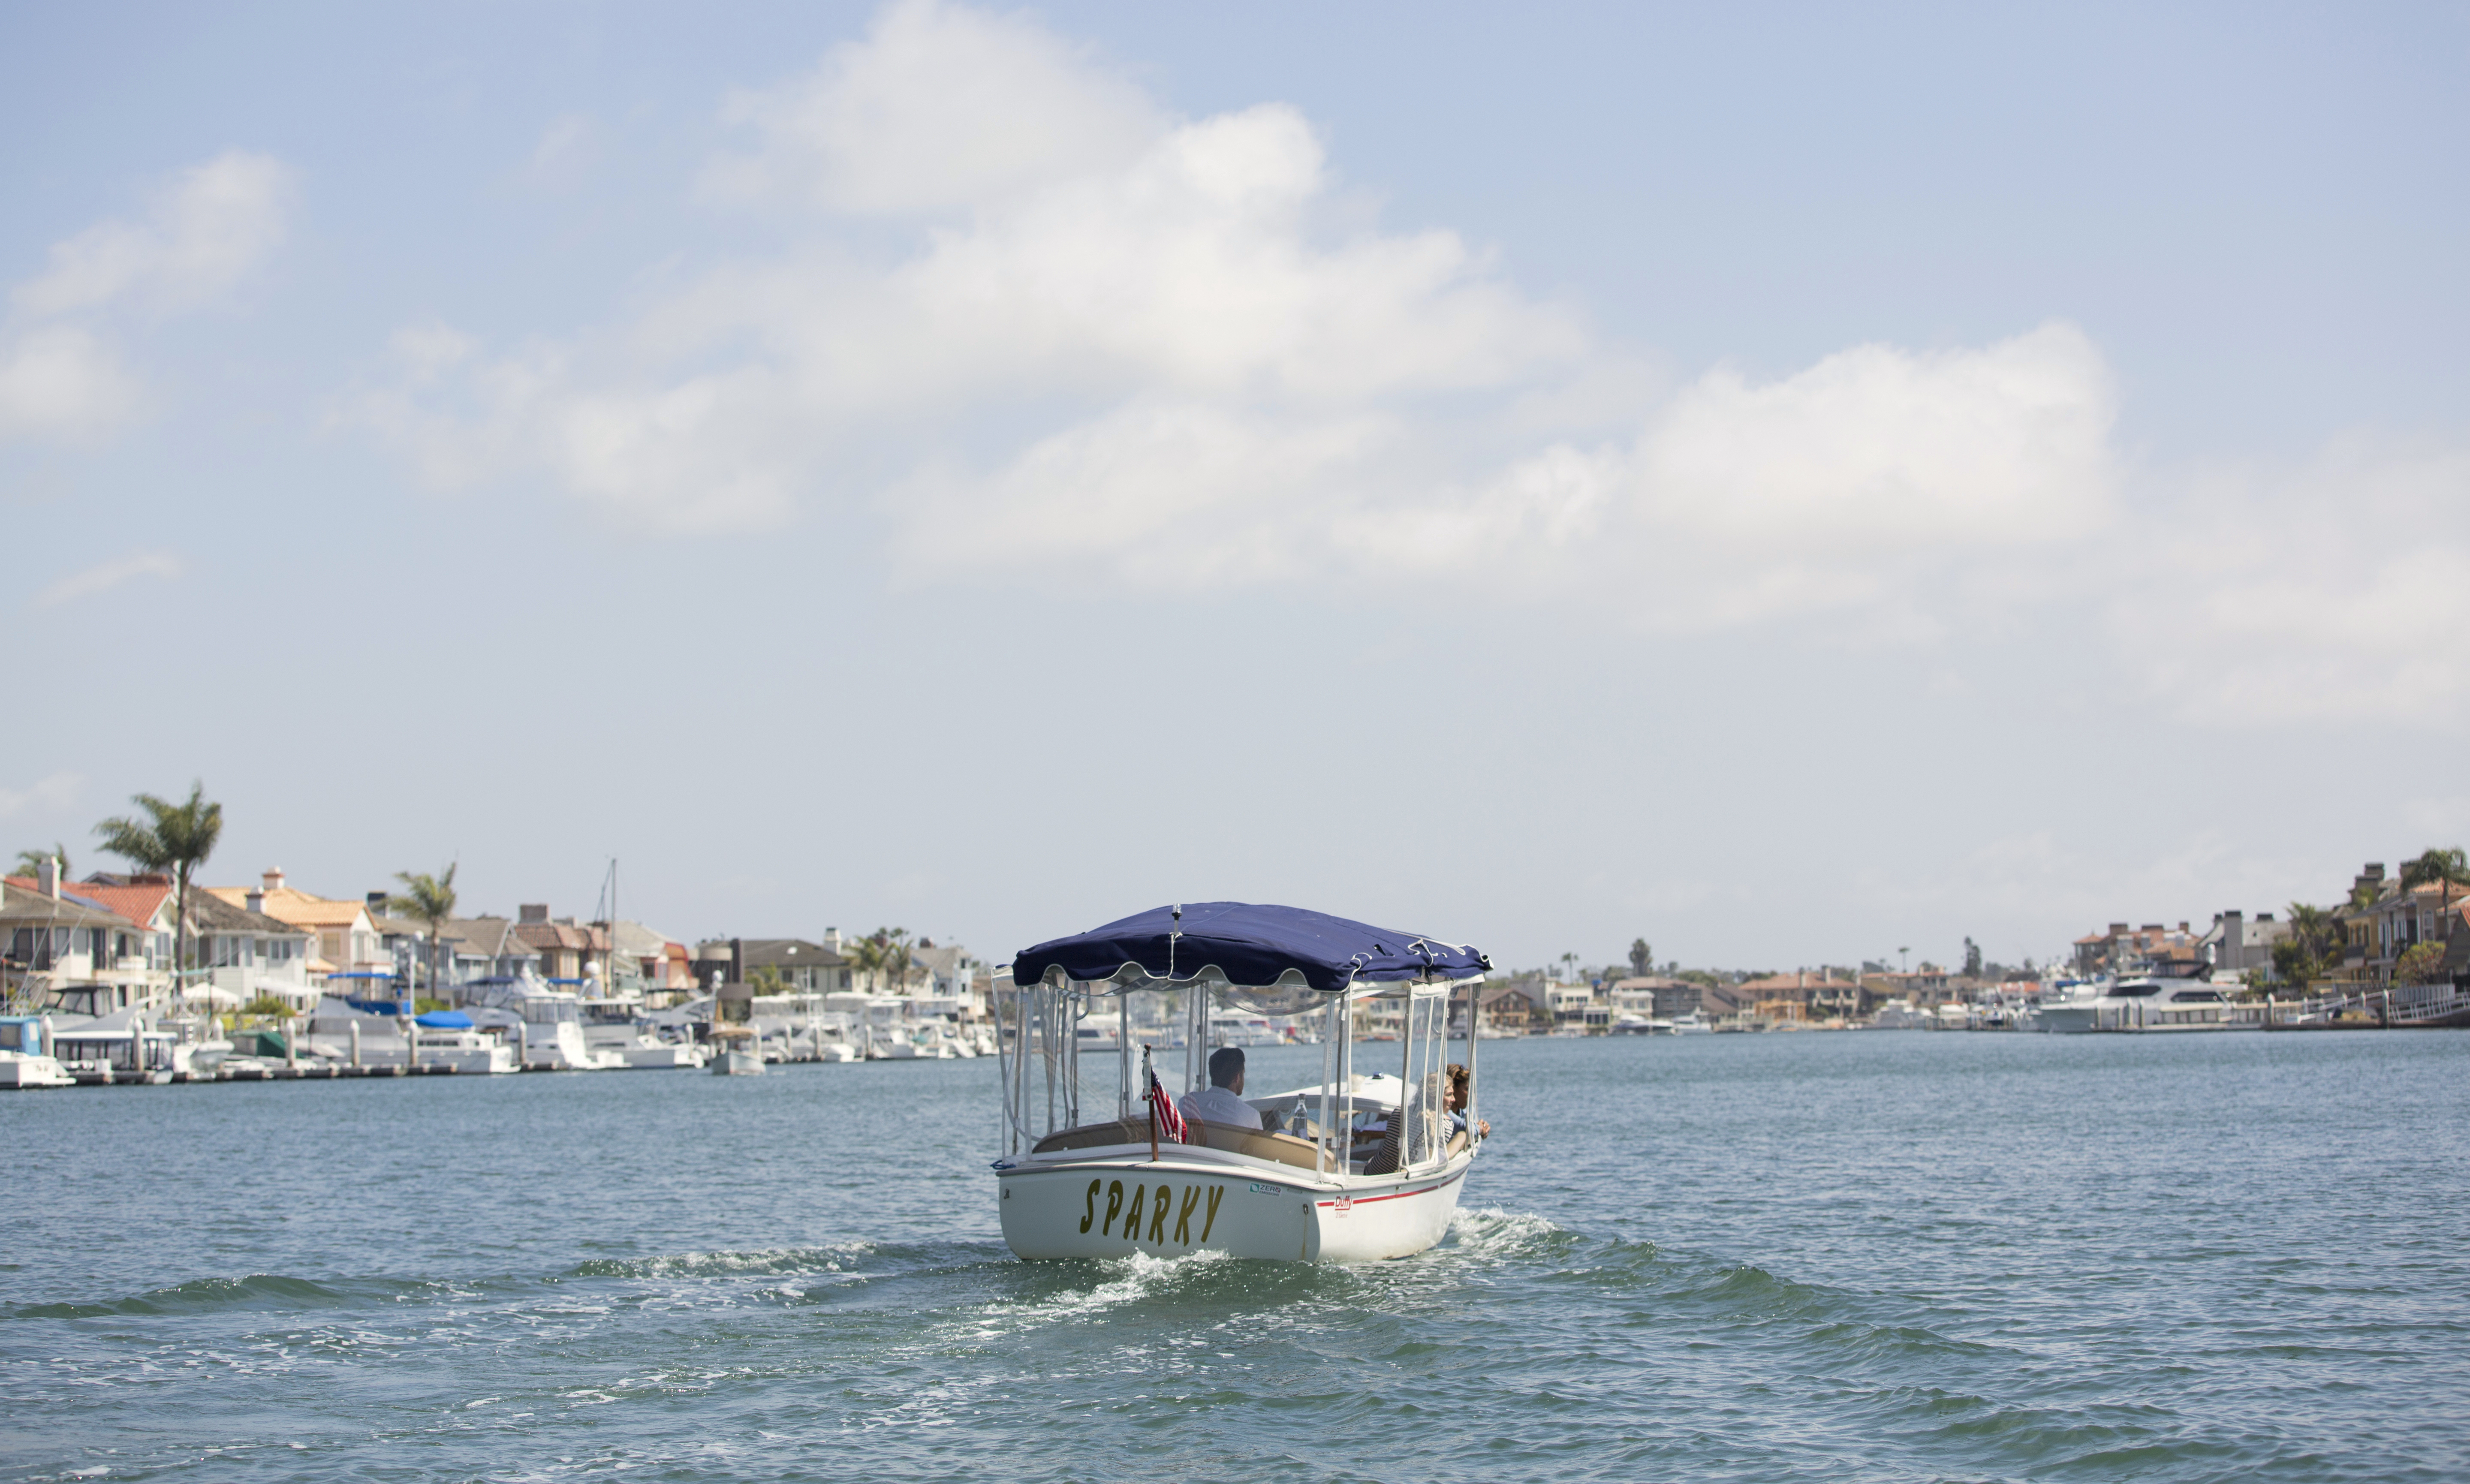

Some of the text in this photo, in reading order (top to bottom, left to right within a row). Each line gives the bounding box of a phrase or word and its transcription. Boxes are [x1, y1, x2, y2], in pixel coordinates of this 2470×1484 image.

[1260, 1184, 1281, 1193] ZERO
[1335, 1195, 1352, 1210] Duffy
[1080, 1179, 1224, 1247] SPARKY
